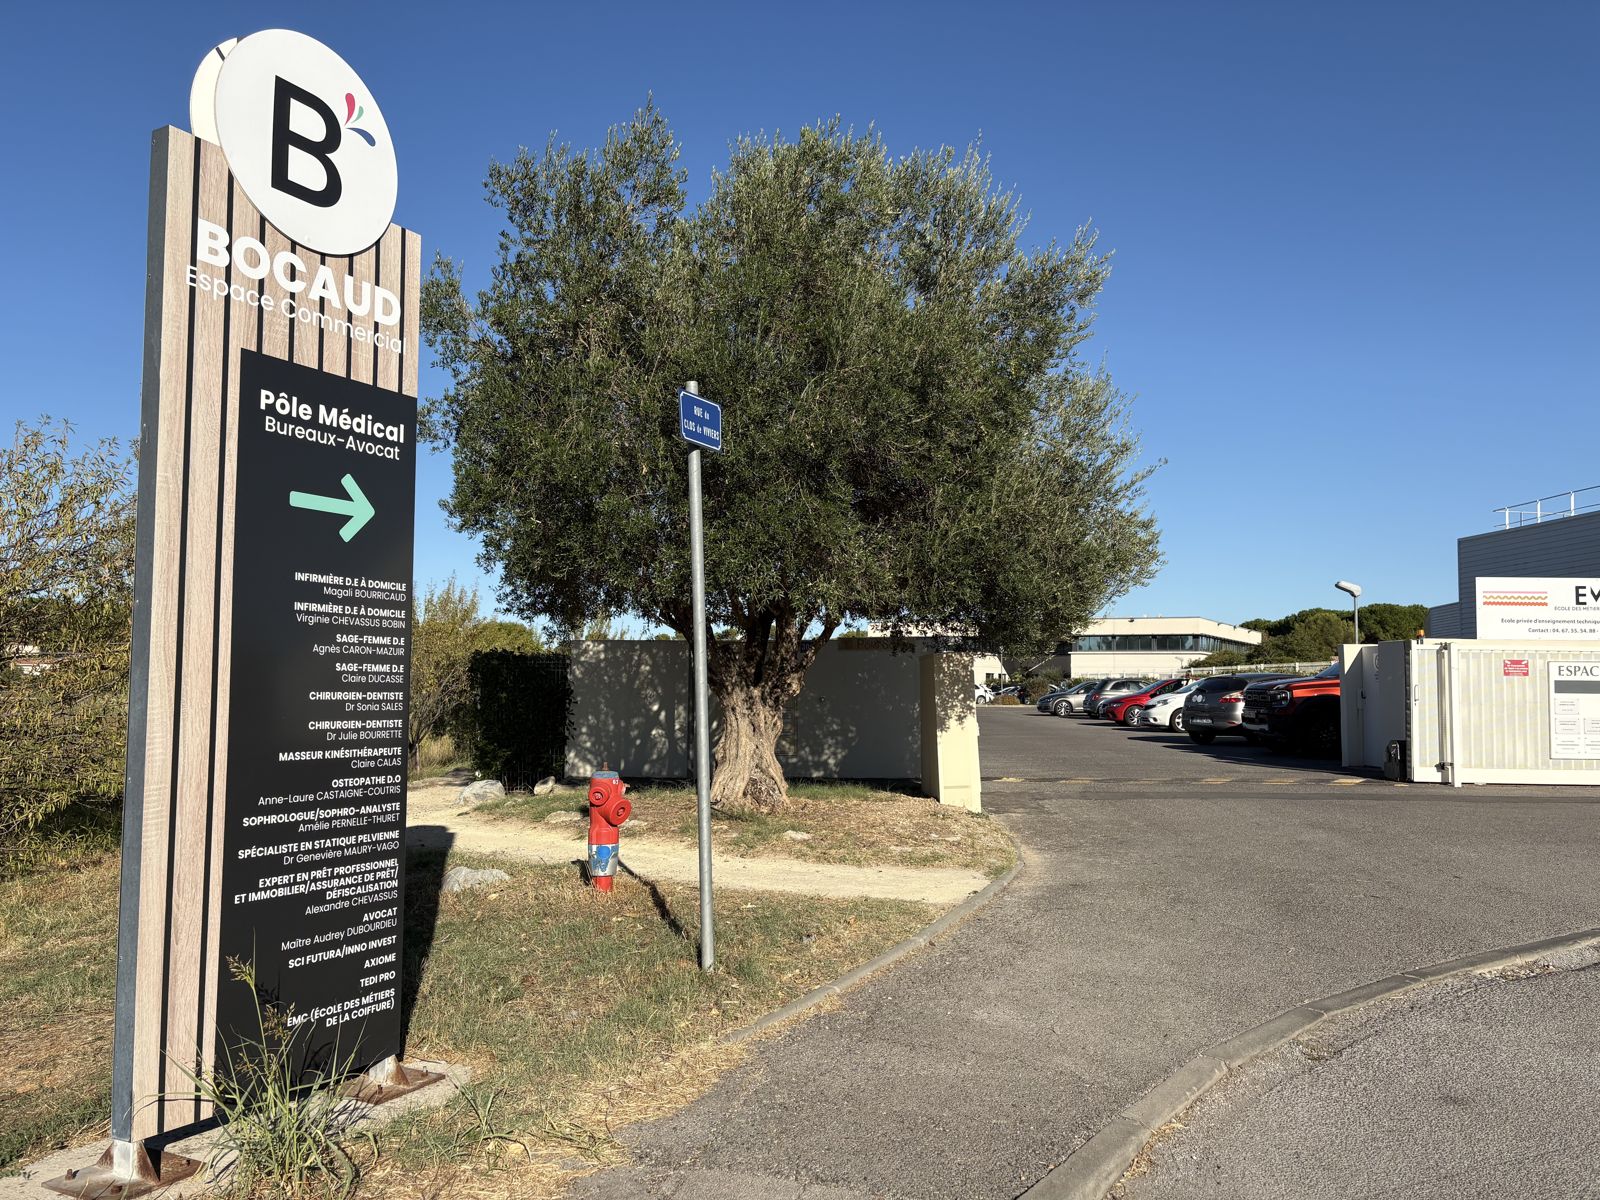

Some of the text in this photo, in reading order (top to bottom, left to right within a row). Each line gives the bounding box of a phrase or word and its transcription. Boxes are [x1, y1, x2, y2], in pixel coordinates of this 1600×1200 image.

[271, 75, 342, 208] B
[198, 218, 401, 326] BOCAUD
[186, 264, 406, 354] Espace Commercial
[260, 388, 404, 444] Pôle Médical
[265, 416, 400, 461] Bureaux-Avocat
[294, 572, 406, 592] INFIRMIÈRE D.E À DOMICILE
[323, 586, 406, 602] Magali BOURRICAUD
[294, 602, 406, 618] INFIRMIÈRE D.E À DOMICILE
[296, 613, 406, 629] Virginie CHEVASSUS BOBIN
[336, 634, 405, 646] SAGE-FEMME D.E
[312, 644, 404, 656] Agnès CARON-MAZUIR
[336, 663, 404, 672] SAGE-FEMME D.E
[342, 674, 404, 683] Claire DUCASSE
[309, 692, 403, 700] CHIRURGIEN-DENTISTE
[345, 702, 403, 711] Dr Sonia SALES
[308, 720, 402, 730] CHIRURGIEN-DENTISTE
[326, 730, 402, 741] Dr Julie BOURRETTE
[279, 747, 402, 762] MASSEUR KINÉSITHÉRAPEUTE
[351, 758, 401, 768] Claire CALAS
[332, 774, 401, 788] OSTEOPATHE D.O
[258, 786, 401, 806] Anne-Laure CASTAIGNE-COUTRIS
[243, 802, 400, 827] SOPHROLOGUE/SOPHRO-ANALYSTE
[298, 813, 400, 832] Amélie PERNELLE-THURET
[238, 830, 400, 859] SPÉCIALISTE EN STATIQUE PELVIENNE
[284, 855, 294, 865] Dr
[344, 841, 399, 856] MAURY-VAGO
[259, 858, 399, 888] EXPERT EN PRÊT PROFESSIONNEL
[234, 867, 398, 904] ET IMMOBILIER/ASSURANCE DE PRÊT/
[326, 879, 398, 900] DÉFISCALISATION
[305, 890, 398, 916] Alexandre CHEVASSUS
[362, 907, 398, 922] AVOCAT
[281, 918, 397, 952] Maître Audrey DUBOURDIEU
[288, 935, 397, 969] SCI FUTURA/INNO INVEST
[364, 953, 396, 969] AXIOME
[360, 970, 396, 988] TEDI PRO
[287, 988, 395, 1027] EMC (ÉCOLE DES MÉTIERS
[326, 997, 395, 1027] DE LA COIFFURE)
